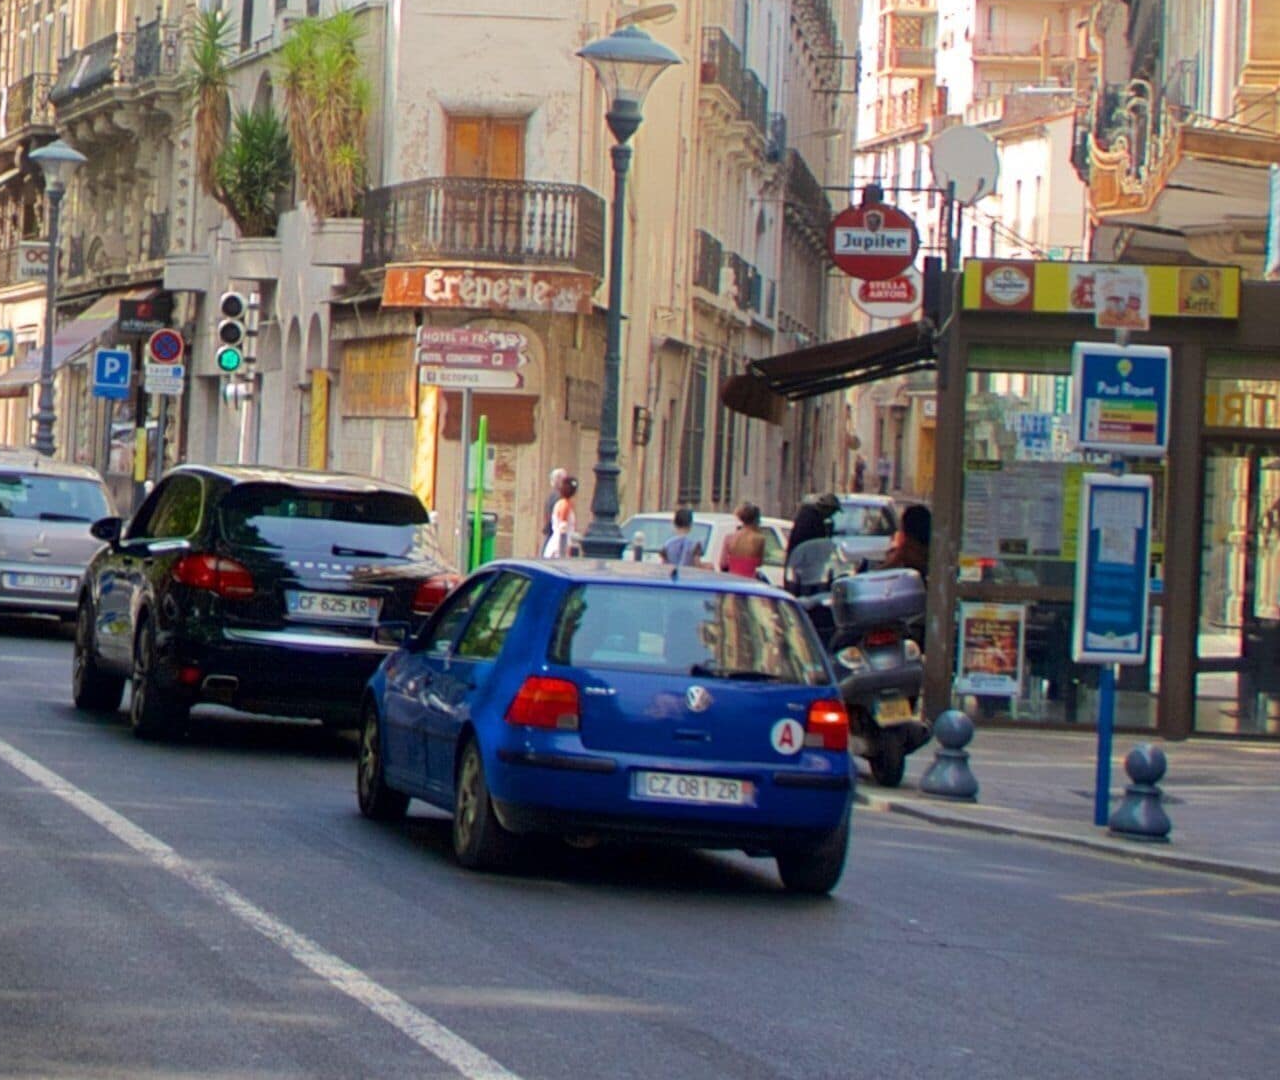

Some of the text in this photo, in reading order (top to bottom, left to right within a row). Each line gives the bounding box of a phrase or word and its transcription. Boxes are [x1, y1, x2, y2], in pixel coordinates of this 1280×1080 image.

[843, 232, 907, 251] Jupiler
[104, 357, 120, 379] P
[778, 723, 794, 748] A
